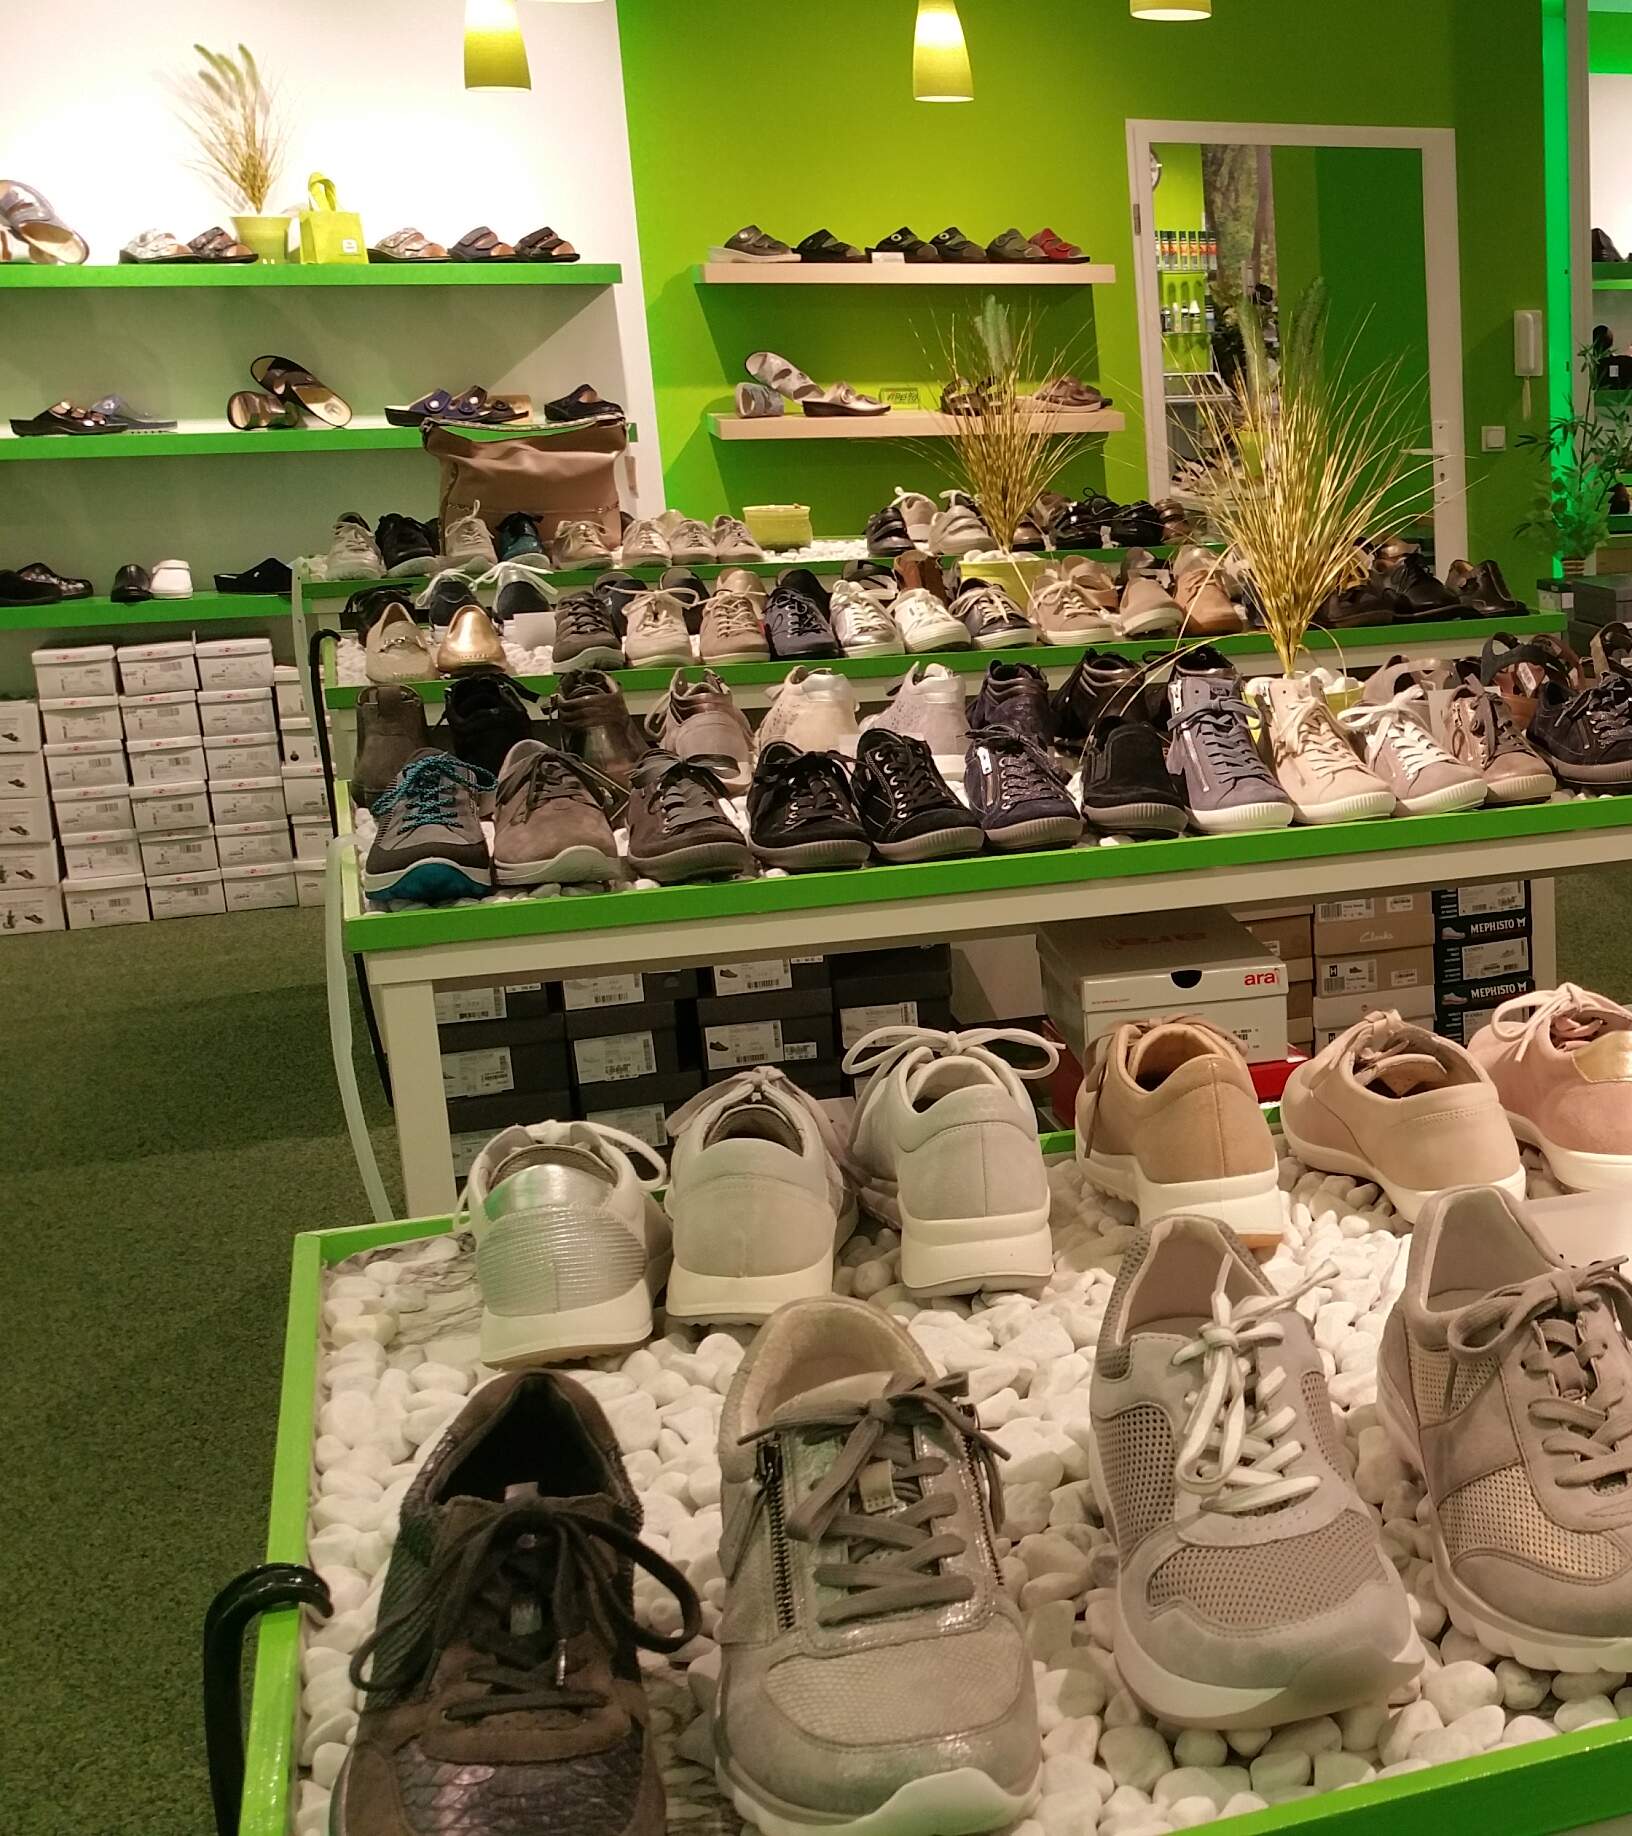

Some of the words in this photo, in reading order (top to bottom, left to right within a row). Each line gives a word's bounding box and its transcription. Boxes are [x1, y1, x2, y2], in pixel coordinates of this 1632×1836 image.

[1470, 918, 1515, 934] MEPHISTO
[1244, 972, 1276, 986] ara
[1471, 983, 1516, 999] MEPHISTO
